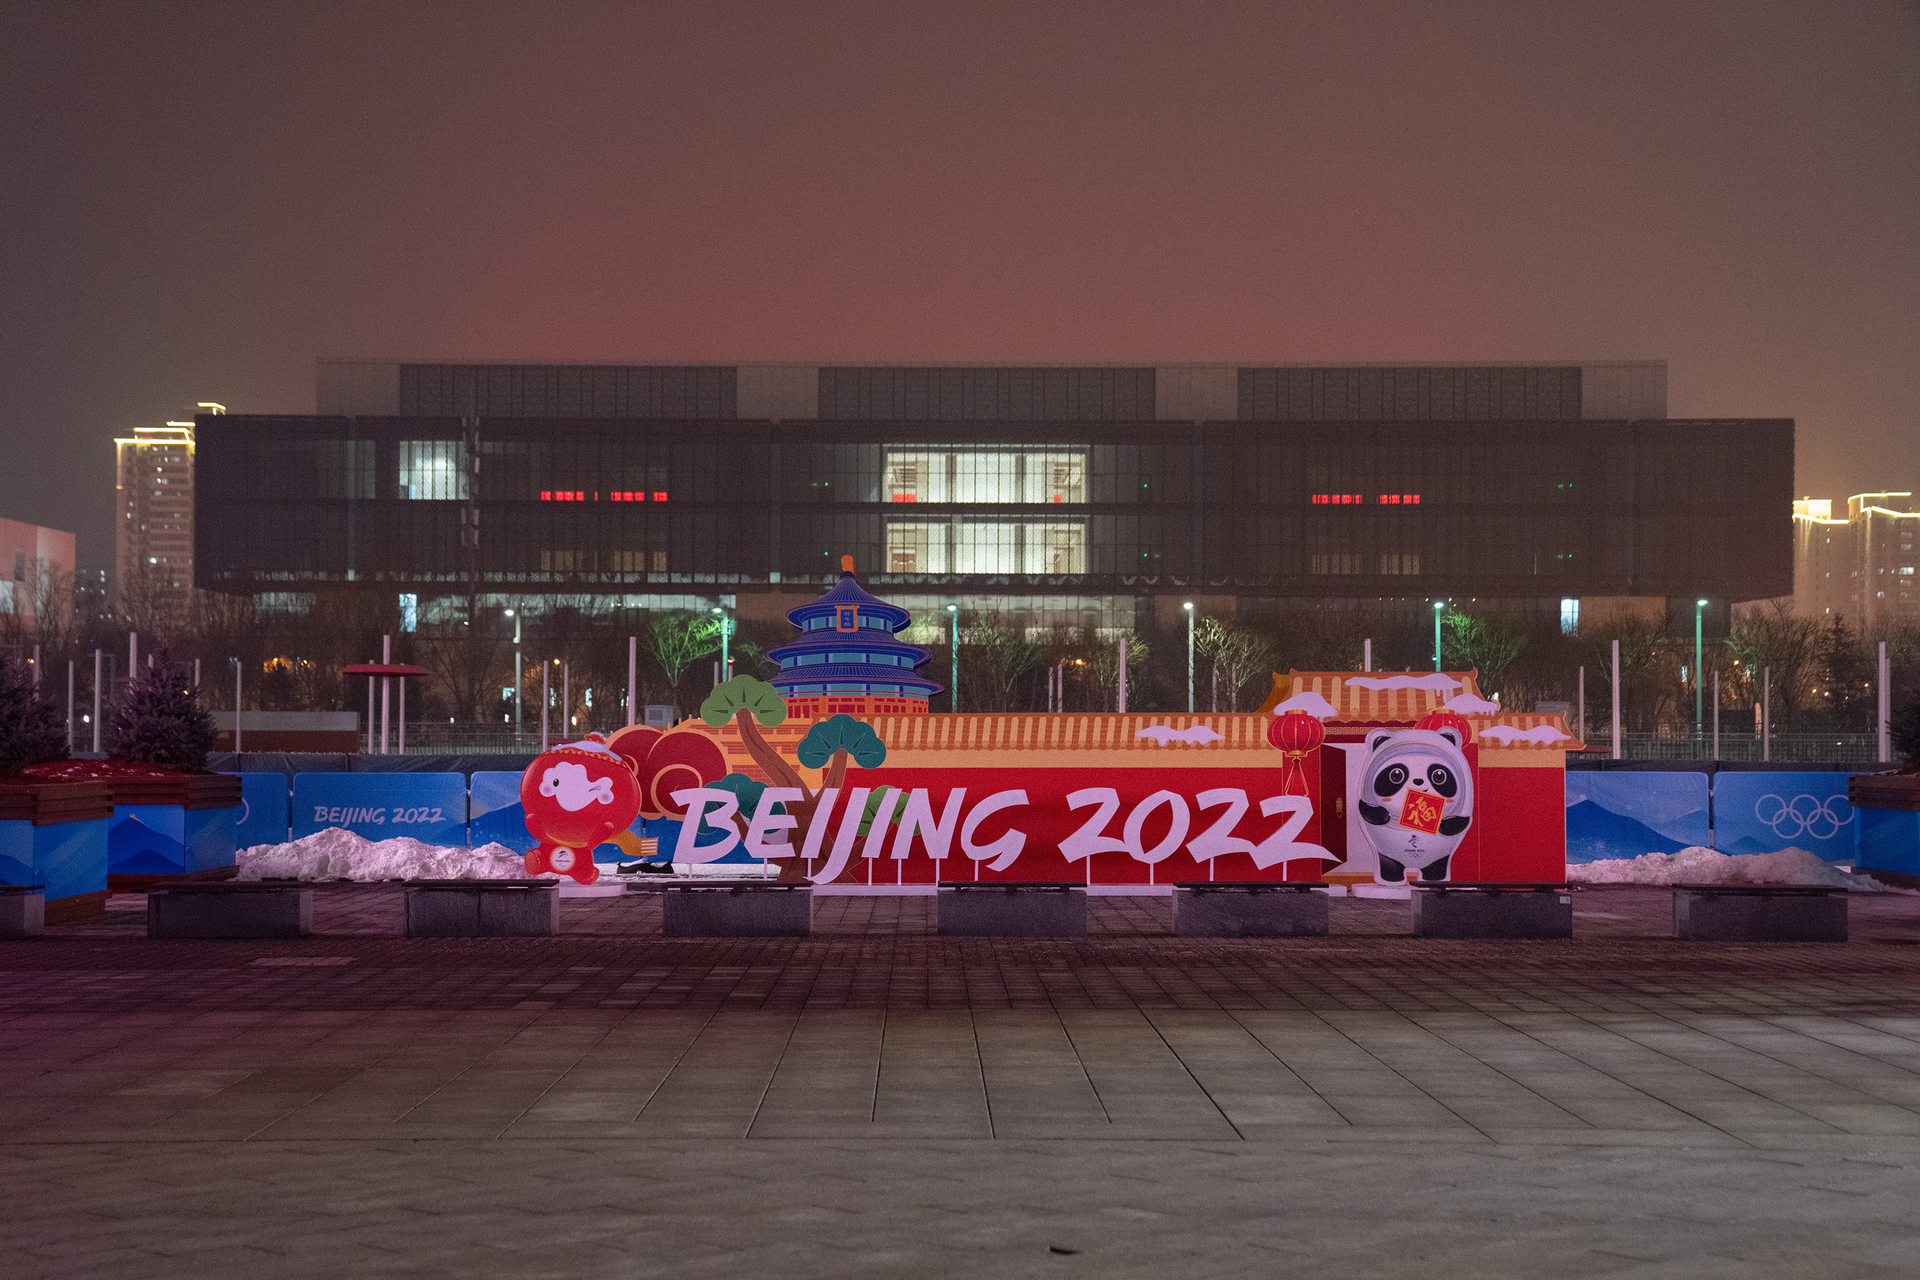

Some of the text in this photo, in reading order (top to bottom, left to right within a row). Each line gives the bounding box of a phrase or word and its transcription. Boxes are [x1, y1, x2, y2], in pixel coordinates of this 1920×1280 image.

[314, 806, 447, 828] BEIJING 2022
[1407, 796, 1437, 827] 福
[669, 787, 1343, 884] BEIJING 2022
